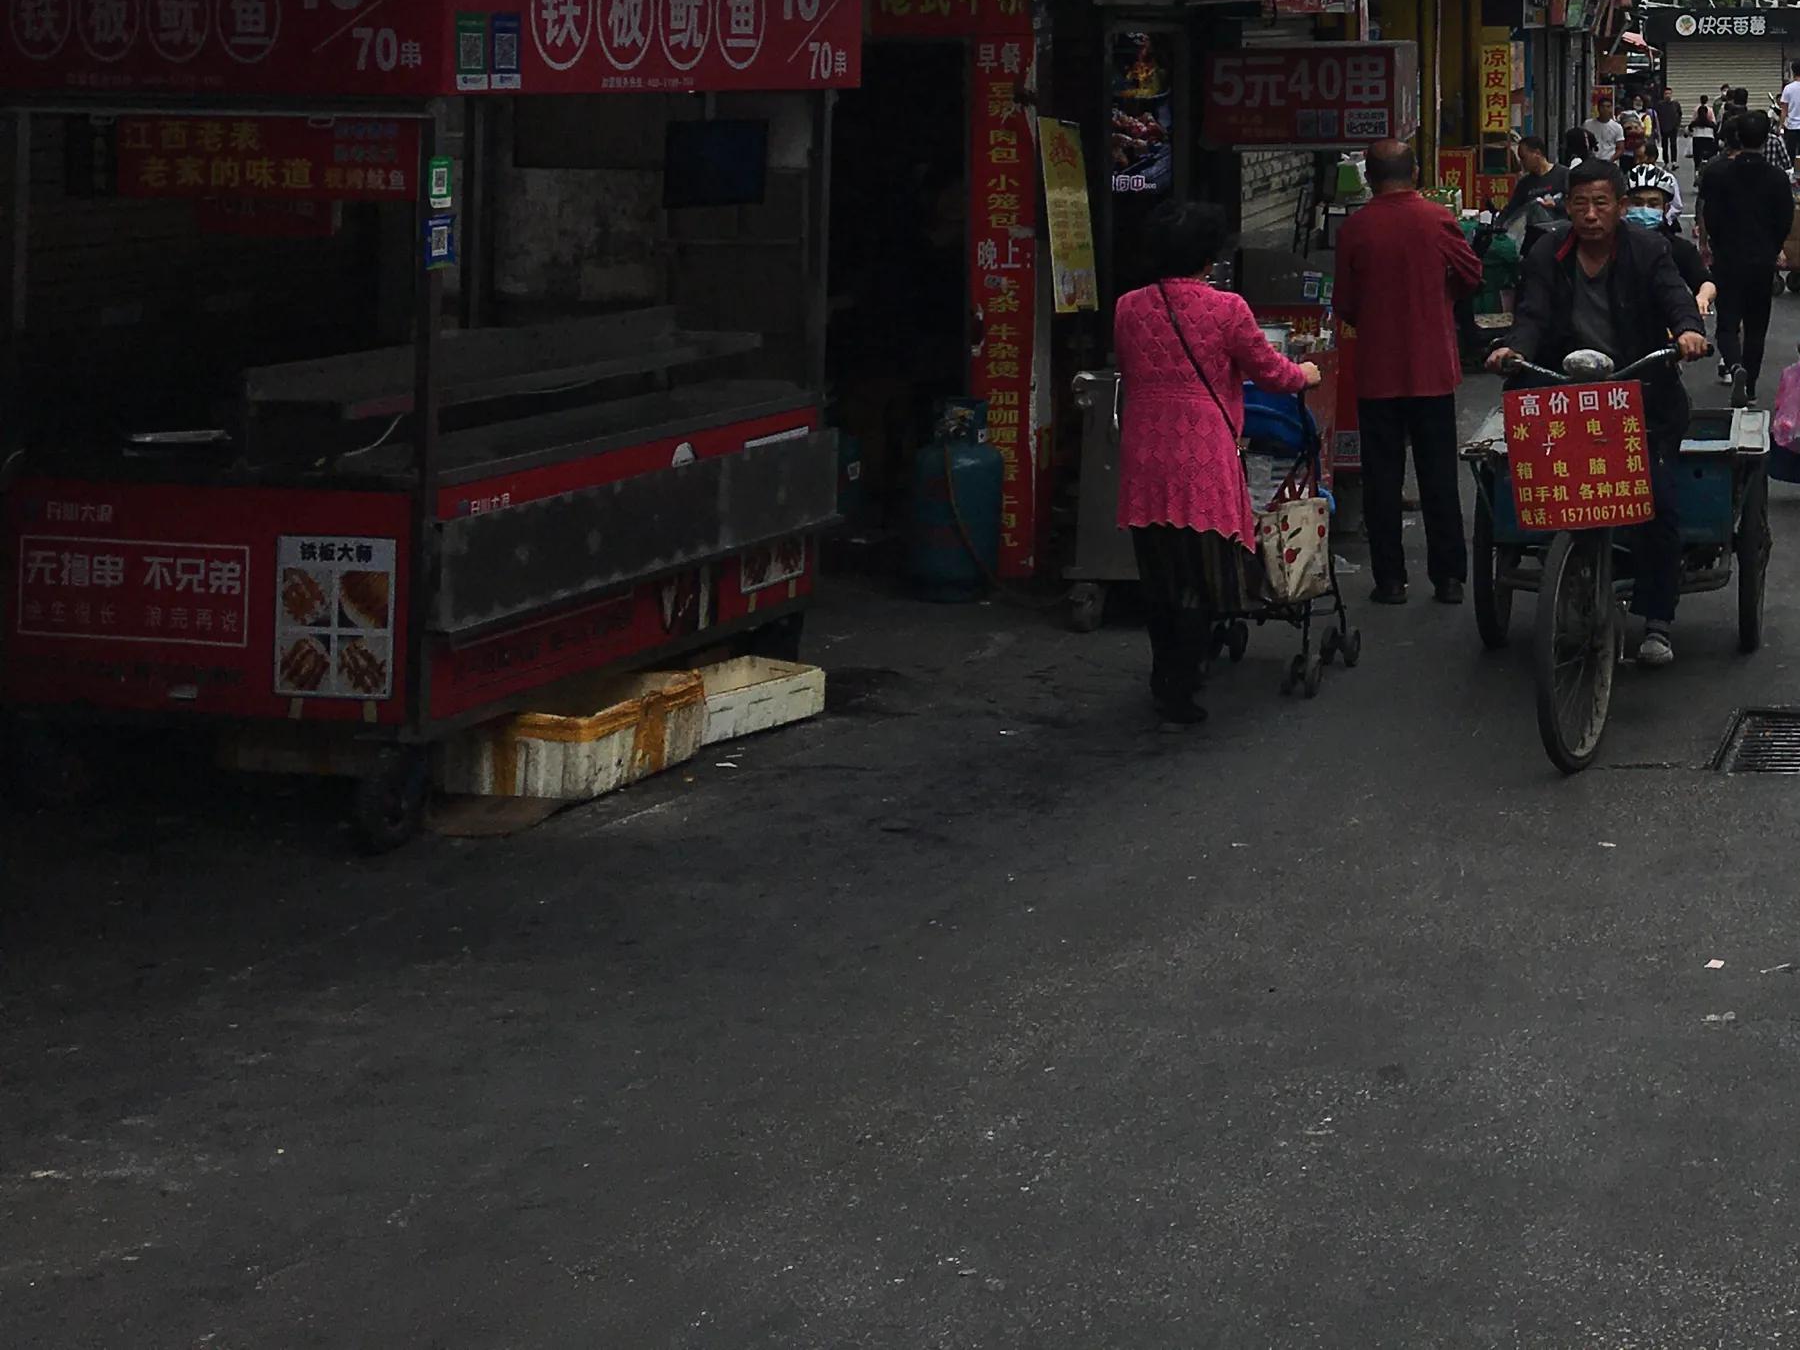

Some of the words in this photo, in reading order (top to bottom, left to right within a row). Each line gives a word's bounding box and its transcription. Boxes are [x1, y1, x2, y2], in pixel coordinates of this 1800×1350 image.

[352, 27, 423, 72] 70串
[809, 41, 848, 81] 70串
[1211, 56, 1387, 107] 5元40串
[1484, 50, 1507, 128] 凉皮肉片
[138, 157, 314, 190] 老家的味道
[1518, 387, 1630, 417] 高价回收
[1518, 484, 1570, 503] 旧手机
[1578, 479, 1651, 500] 各种废品
